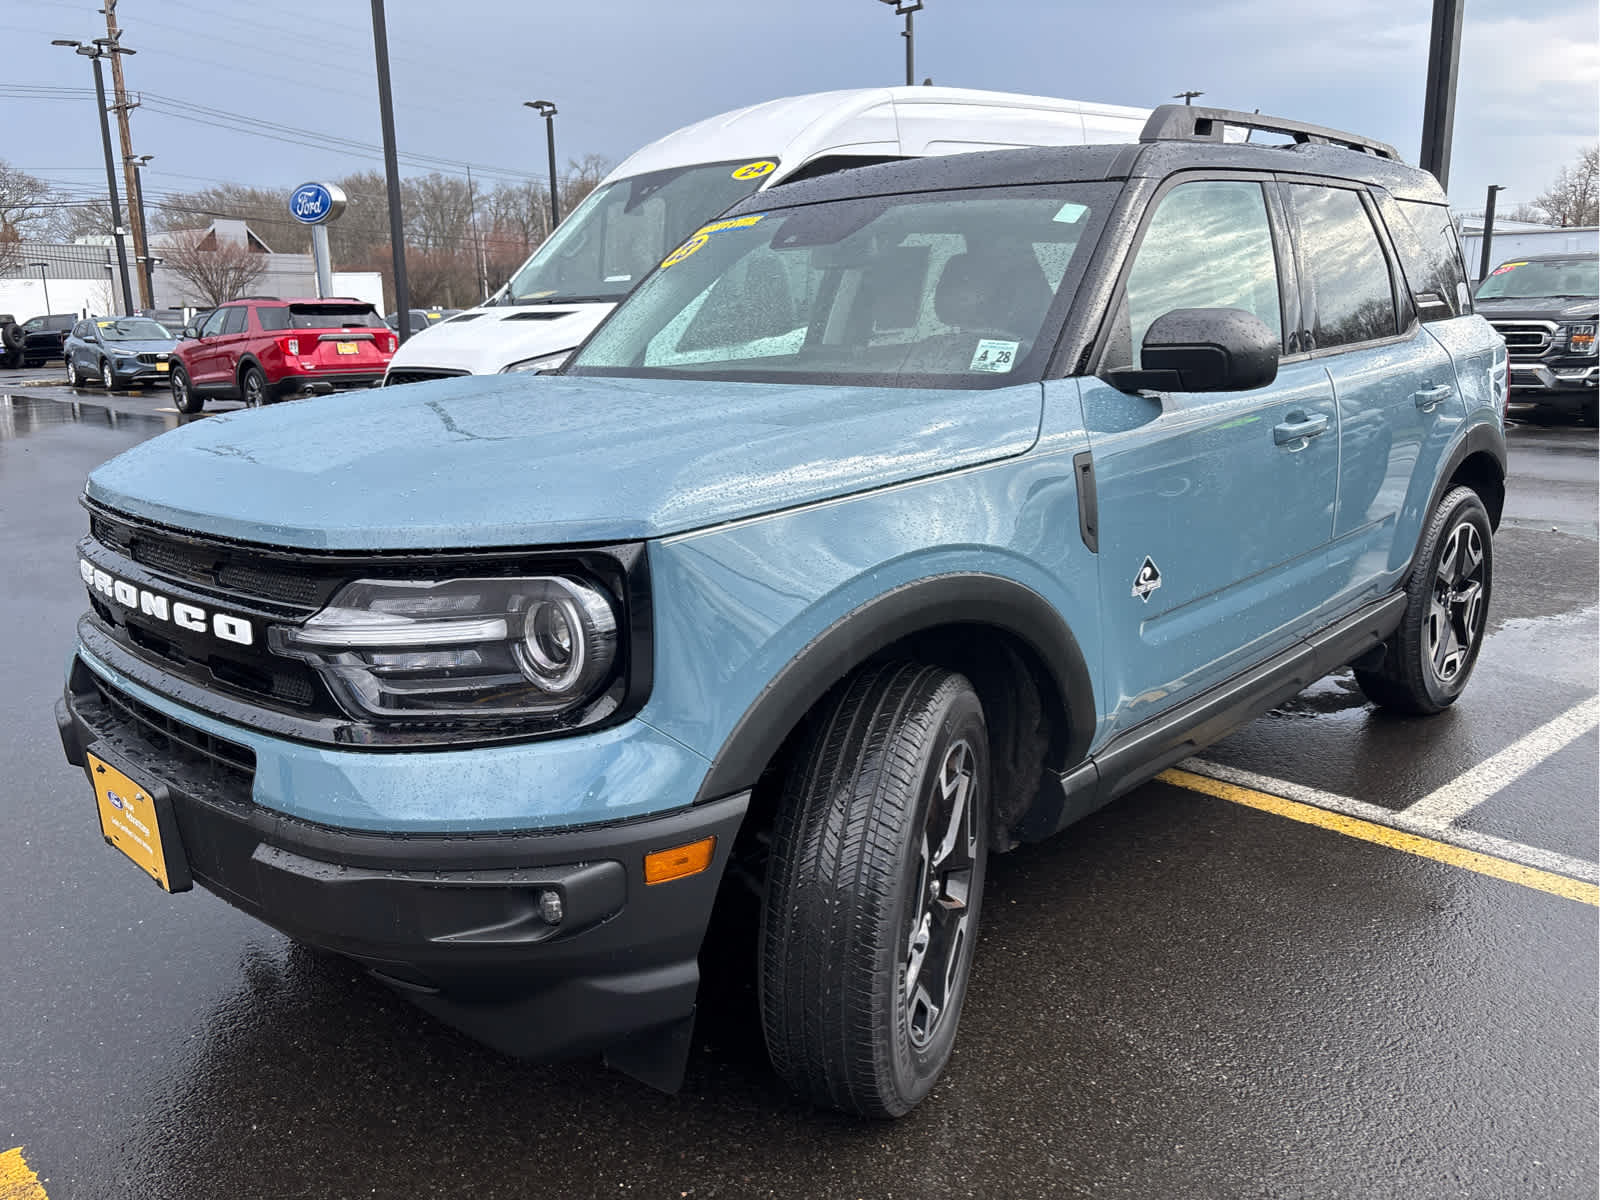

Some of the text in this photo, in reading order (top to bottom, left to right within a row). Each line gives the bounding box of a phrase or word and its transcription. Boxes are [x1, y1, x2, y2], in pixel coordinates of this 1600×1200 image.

[740, 162, 769, 177] 24
[296, 191, 322, 216] Ford
[995, 350, 1012, 364] 28
[80, 558, 254, 646] BRONCO
